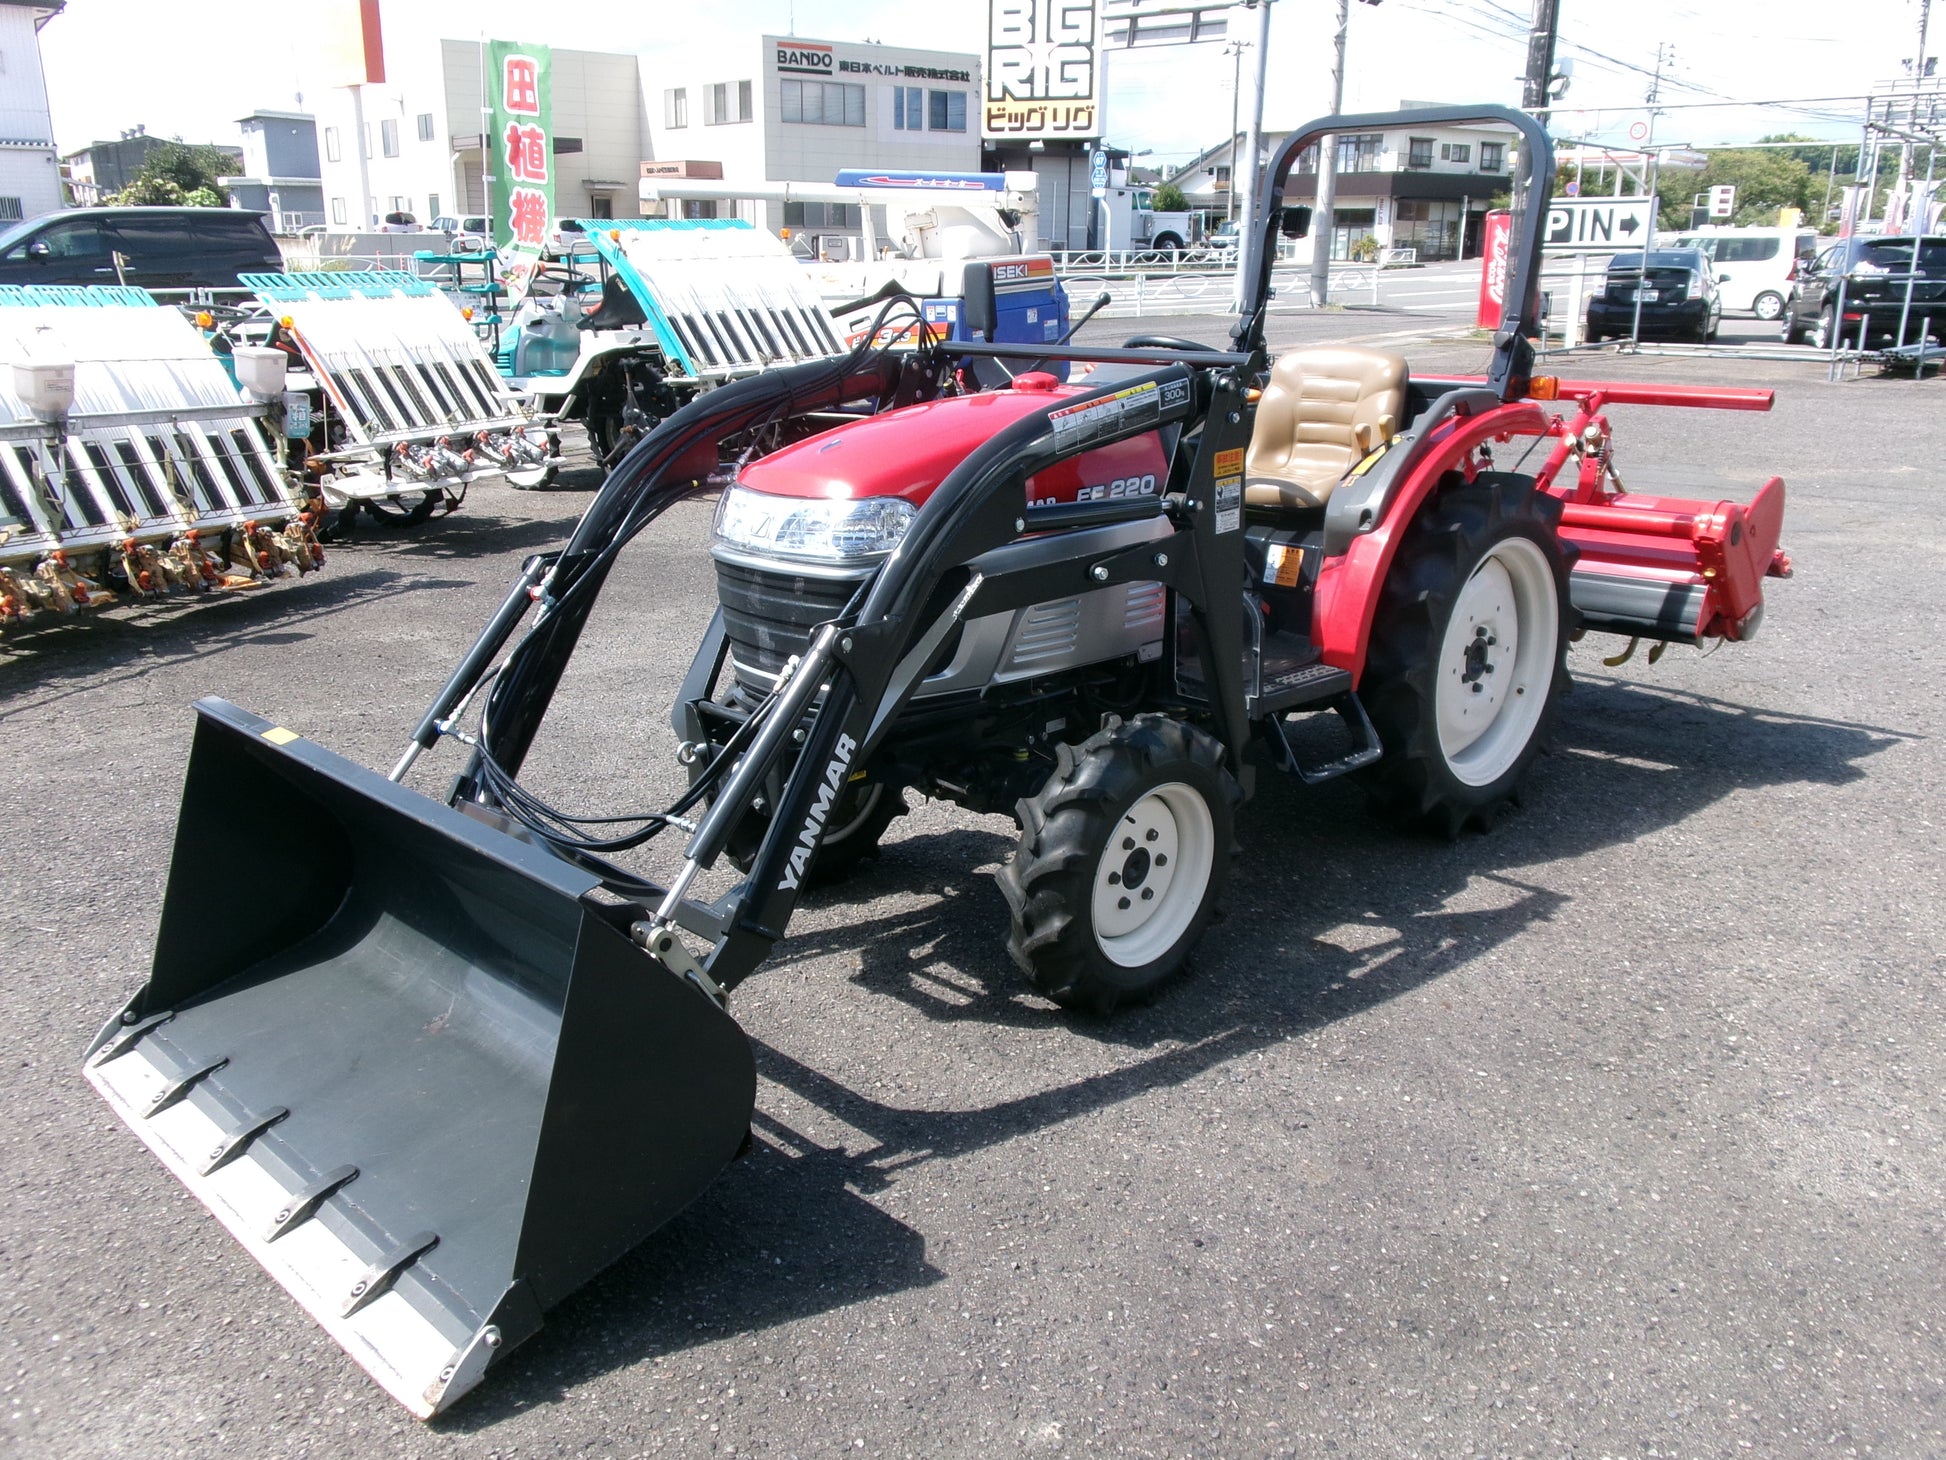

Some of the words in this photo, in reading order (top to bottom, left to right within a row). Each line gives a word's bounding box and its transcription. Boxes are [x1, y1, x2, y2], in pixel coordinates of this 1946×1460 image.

[990, 0, 1092, 44] BIG
[777, 49, 833, 68] BANDO
[989, 46, 1092, 99] RIG
[505, 56, 548, 246] 田植機
[1545, 209, 1570, 242] P
[1578, 208, 1615, 242] IN
[993, 264, 1028, 280] ISEKI
[1109, 474, 1156, 499] 220
[777, 732, 857, 890] YANMAR
